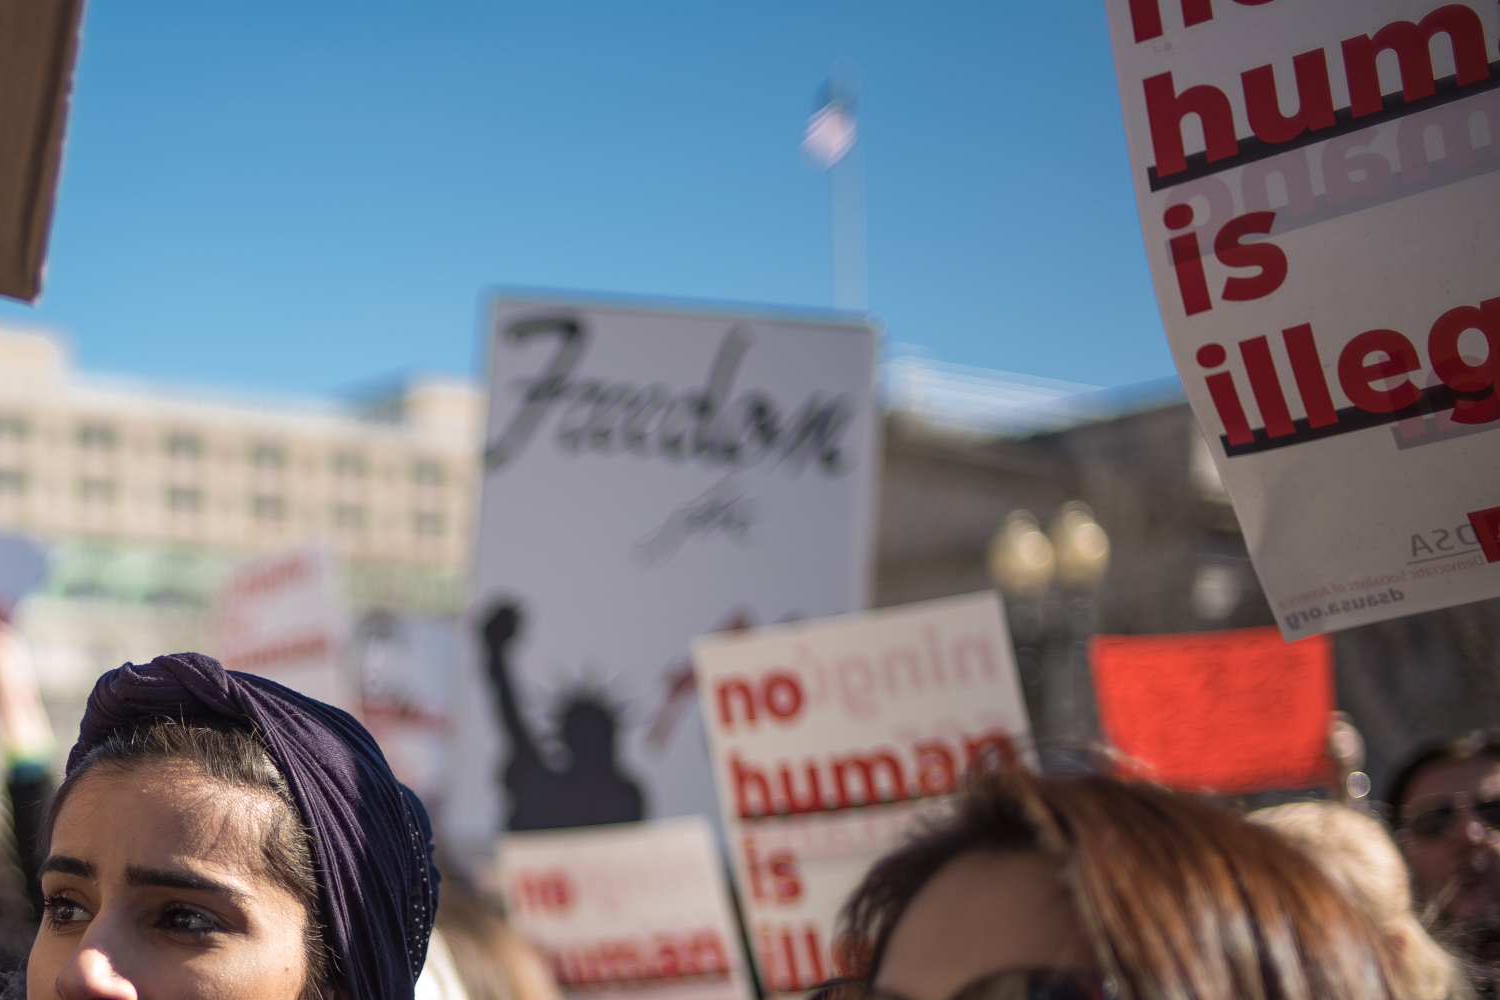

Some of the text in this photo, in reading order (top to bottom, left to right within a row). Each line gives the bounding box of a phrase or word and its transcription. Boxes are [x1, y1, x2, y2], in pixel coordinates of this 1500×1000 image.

[1163, 203, 1289, 317] is
[715, 667, 806, 730] no
[746, 836, 803, 905] is
